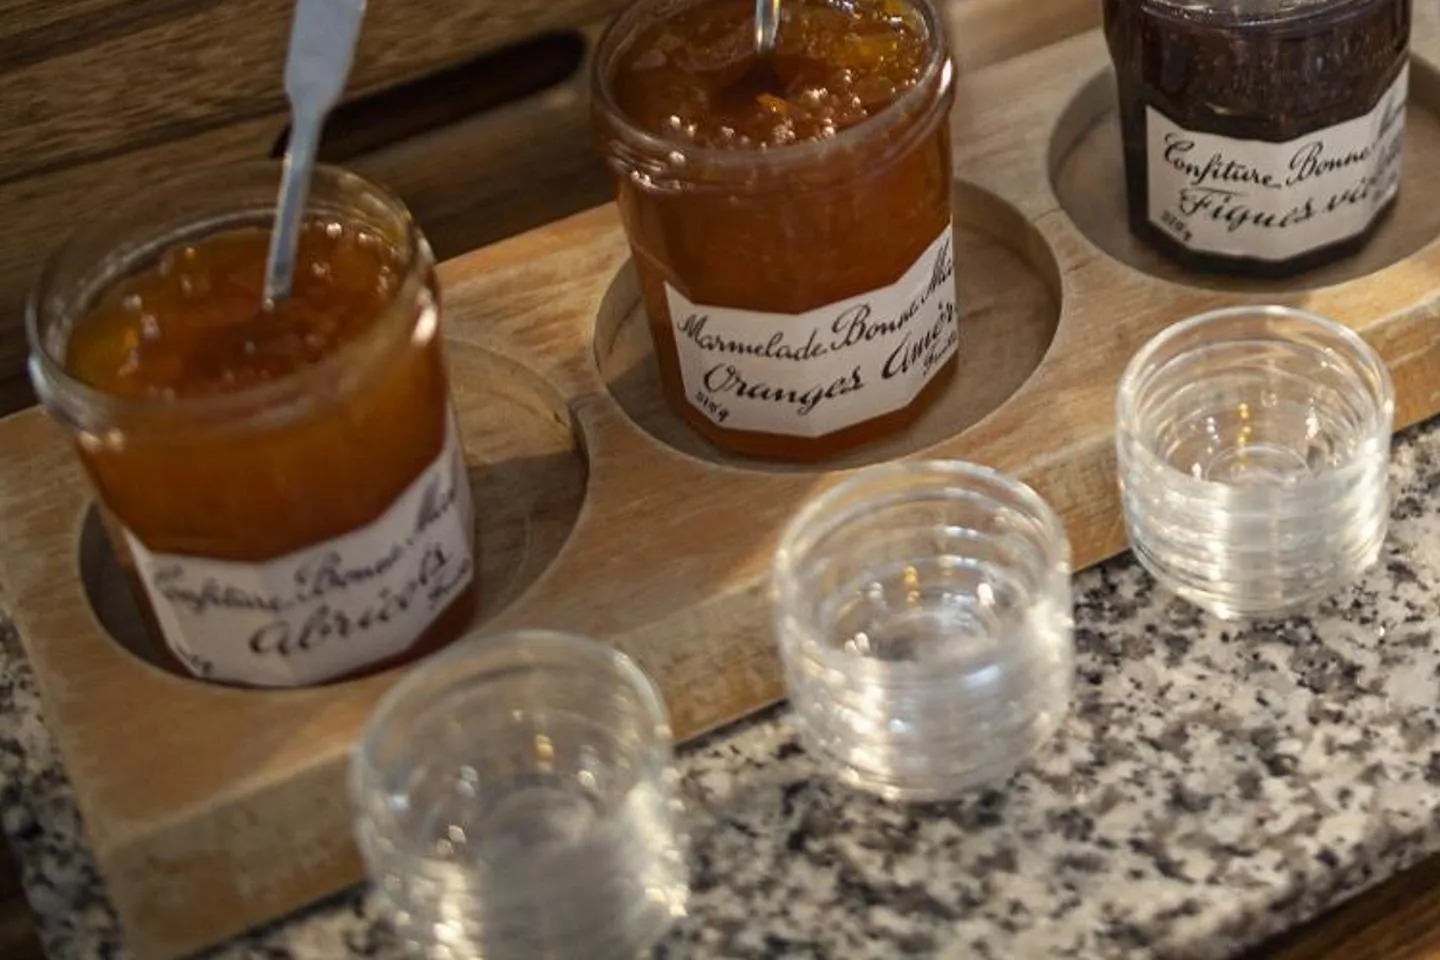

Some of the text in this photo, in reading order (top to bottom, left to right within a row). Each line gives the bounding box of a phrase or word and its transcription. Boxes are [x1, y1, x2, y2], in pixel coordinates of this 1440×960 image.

[1163, 132, 1371, 188] Confiture Bonne
[1178, 187, 1317, 234] Figues
[677, 313, 828, 362] Marmelade
[830, 300, 919, 351] Bonne
[703, 362, 867, 416] Oranges
[249, 543, 448, 656] Abricots
